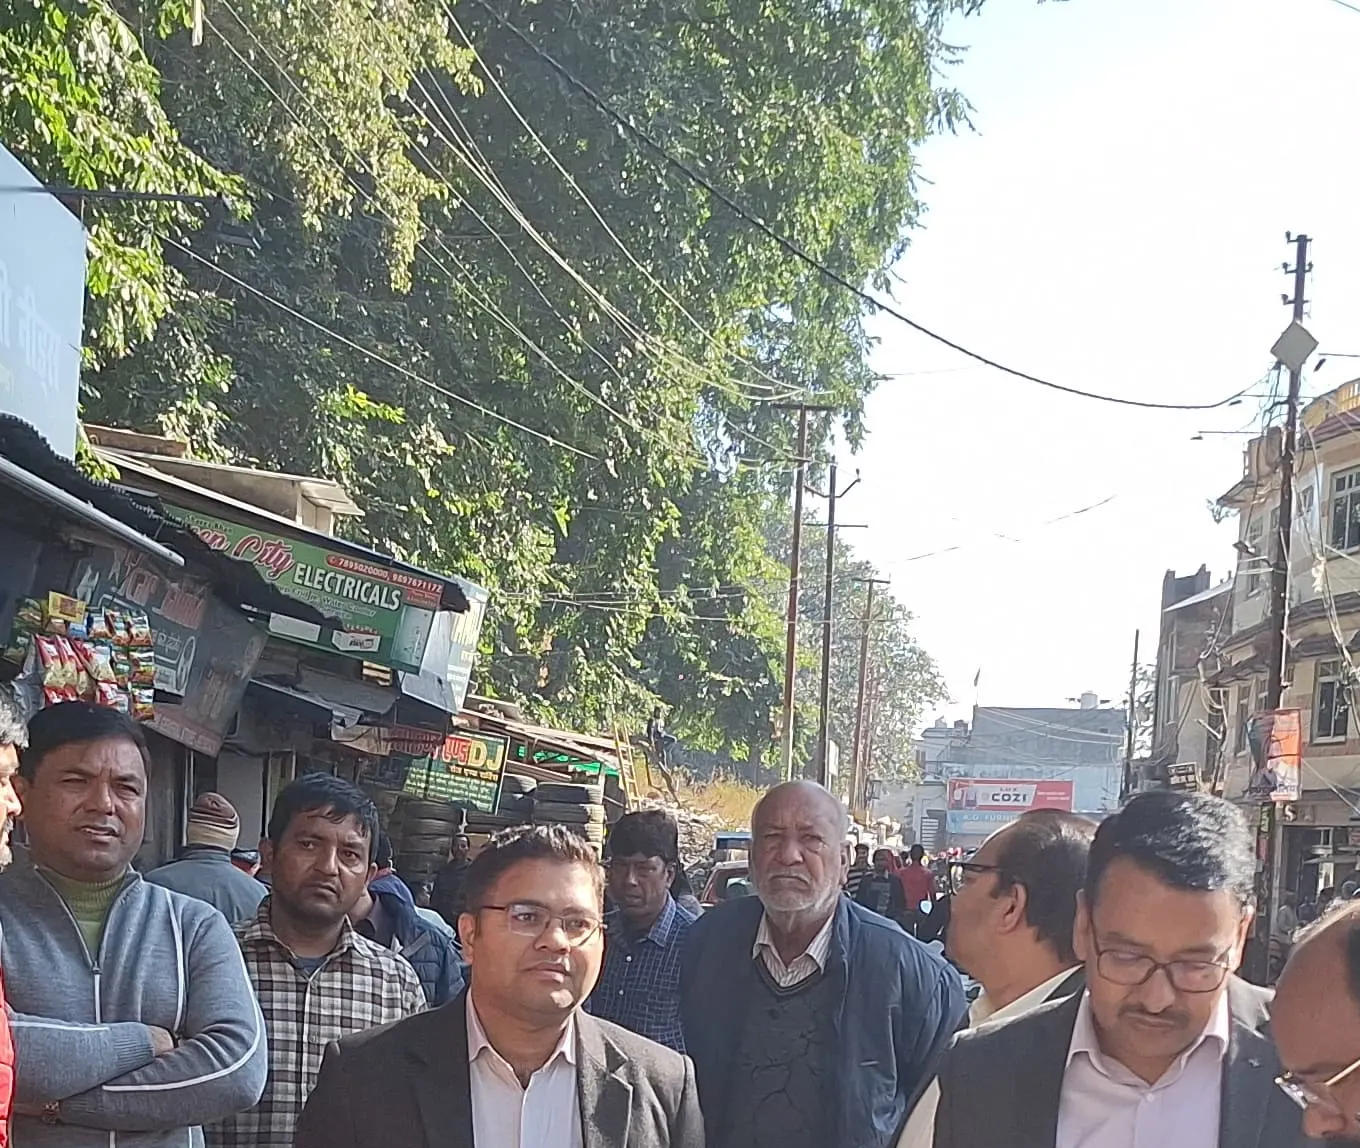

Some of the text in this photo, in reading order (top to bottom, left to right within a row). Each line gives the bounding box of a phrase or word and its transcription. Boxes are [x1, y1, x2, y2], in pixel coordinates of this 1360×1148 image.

[231, 533, 296, 580] City
[292, 562, 402, 612] ELECTRICALS
[468, 740, 504, 771] DJ
[991, 792, 1027, 803] COZI
